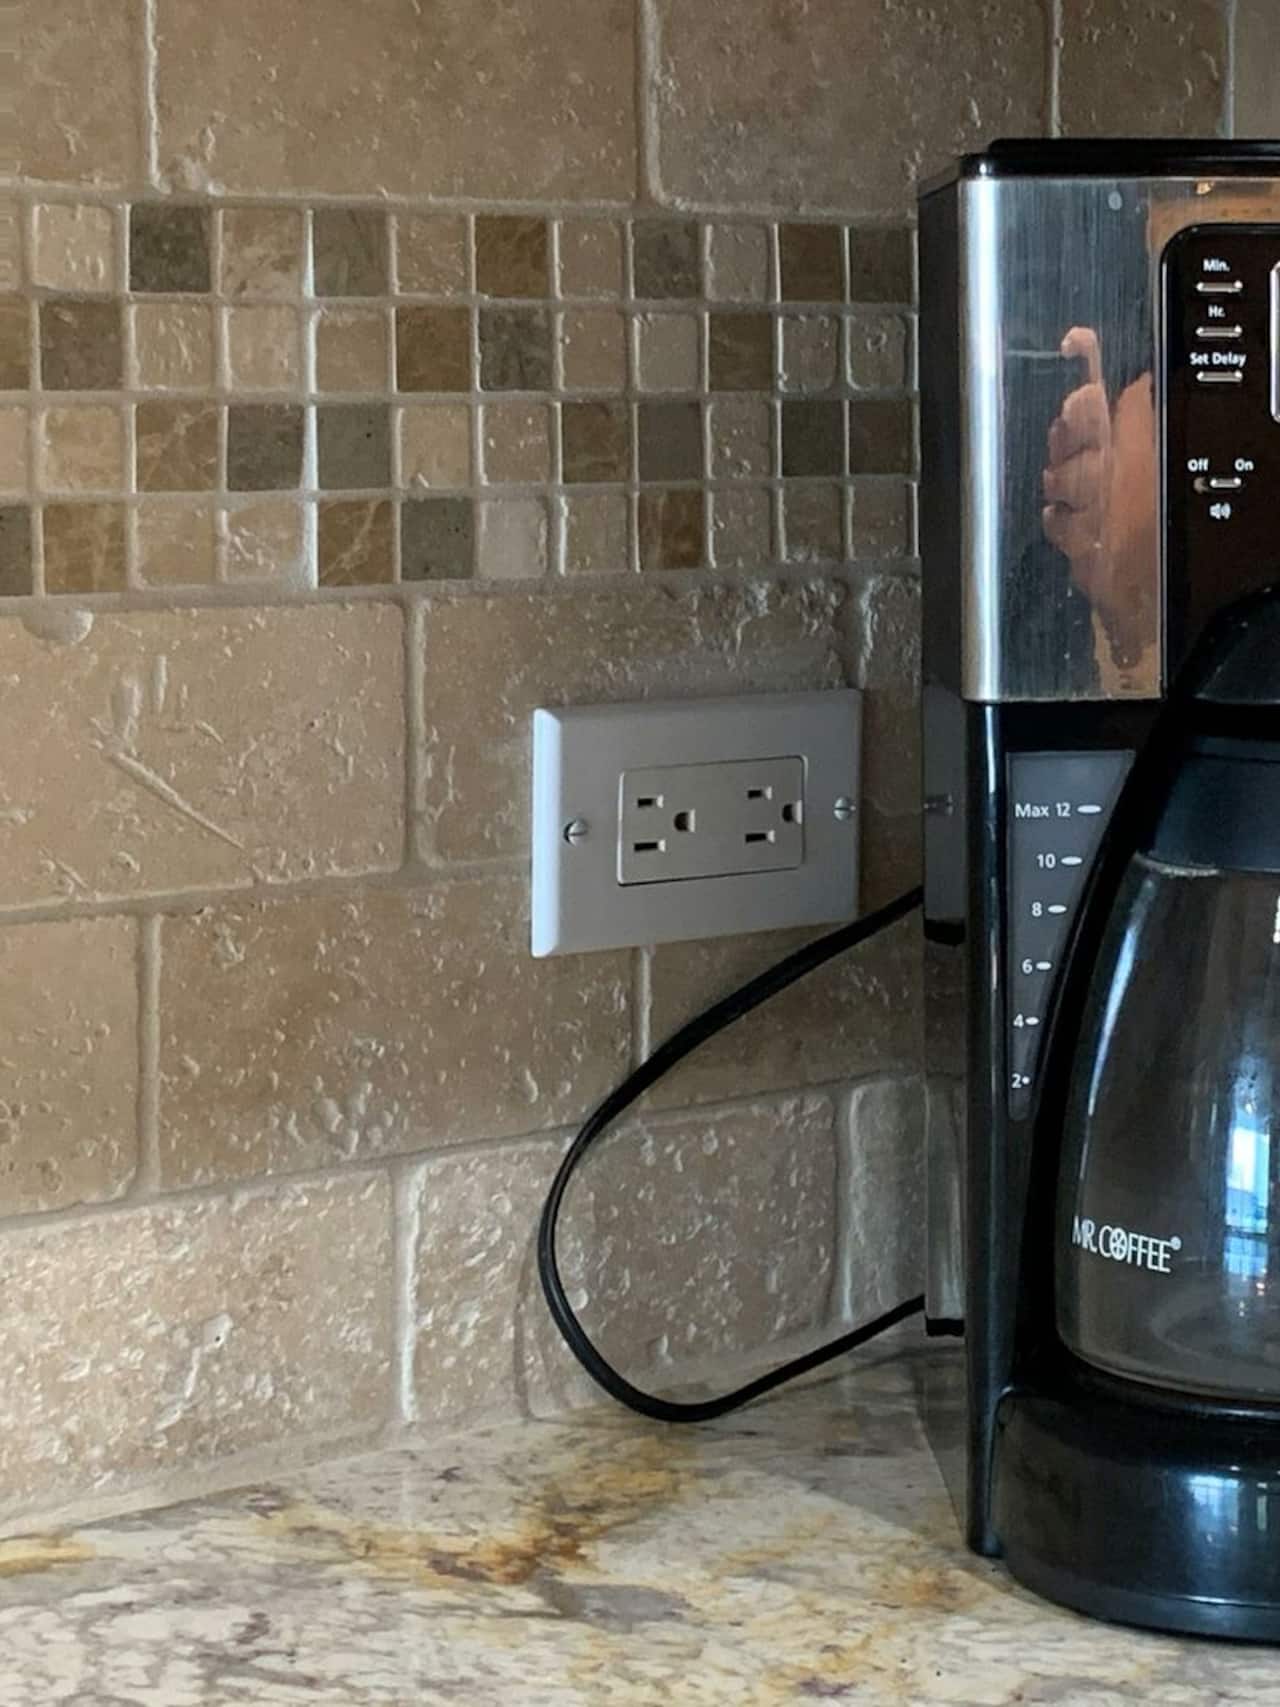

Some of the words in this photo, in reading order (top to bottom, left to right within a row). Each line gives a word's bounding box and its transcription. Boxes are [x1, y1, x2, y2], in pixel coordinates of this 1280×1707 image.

[1203, 258, 1230, 272] Min.
[1189, 351, 1209, 365] Set
[1211, 351, 1247, 368] Delay
[1187, 458, 1209, 472] Off
[1234, 458, 1254, 472] On
[1015, 803, 1050, 818] Max
[1055, 801, 1071, 817] 12
[1037, 853, 1056, 869] 10
[1031, 901, 1043, 917] 8
[1022, 958, 1033, 974] 6
[1013, 1013, 1025, 1028] 4
[1011, 1072, 1022, 1089] 2
